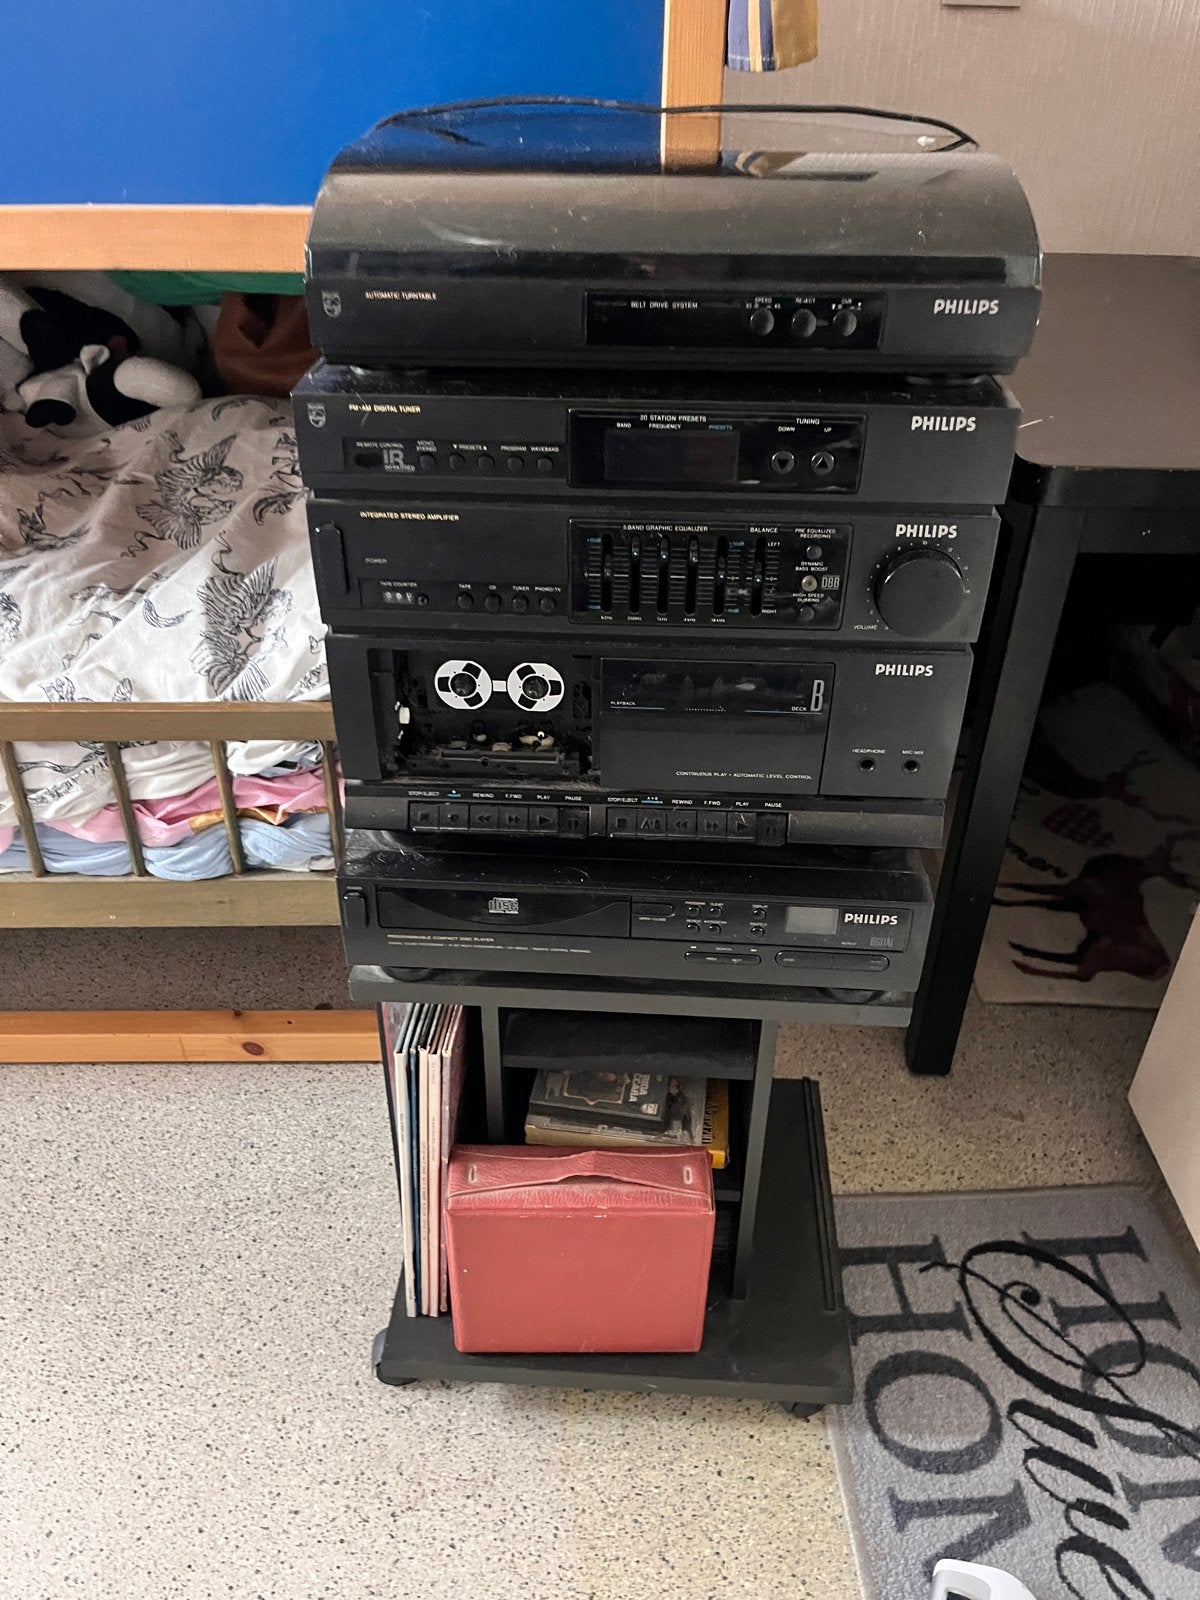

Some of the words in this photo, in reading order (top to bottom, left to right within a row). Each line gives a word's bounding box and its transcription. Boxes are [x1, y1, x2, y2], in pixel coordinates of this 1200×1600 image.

[365, 290, 401, 300] AUTOMATIC
[402, 291, 437, 301] TURNTABLE
[630, 300, 646, 309] BELT
[649, 301, 668, 309] DRIVE
[671, 301, 698, 309] SYSTEM
[933, 298, 1000, 315] PHILIPS
[373, 404, 398, 413] DIGITAL
[399, 405, 421, 413] TUNER
[650, 414, 676, 422] STATION
[678, 415, 707, 423] PRESETS
[796, 417, 820, 426] TUNING
[911, 415, 977, 432] PHILIPS
[382, 448, 404, 471] IR
[359, 511, 399, 519] INTEGRATED
[400, 512, 426, 521] STEREO
[427, 513, 460, 521] AMPLIFIER
[646, 524, 673, 532] GRAPHIC
[675, 525, 708, 533] EQUALIZER
[895, 524, 958, 539] PHILIPS
[365, 557, 388, 565] POWER
[458, 582, 471, 590] TAPE
[821, 576, 840, 588] DBB
[874, 663, 934, 677] PHILIPS
[810, 679, 825, 712] B
[852, 747, 886, 755] HEADPHONE
[844, 912, 898, 926] PHILIPS
